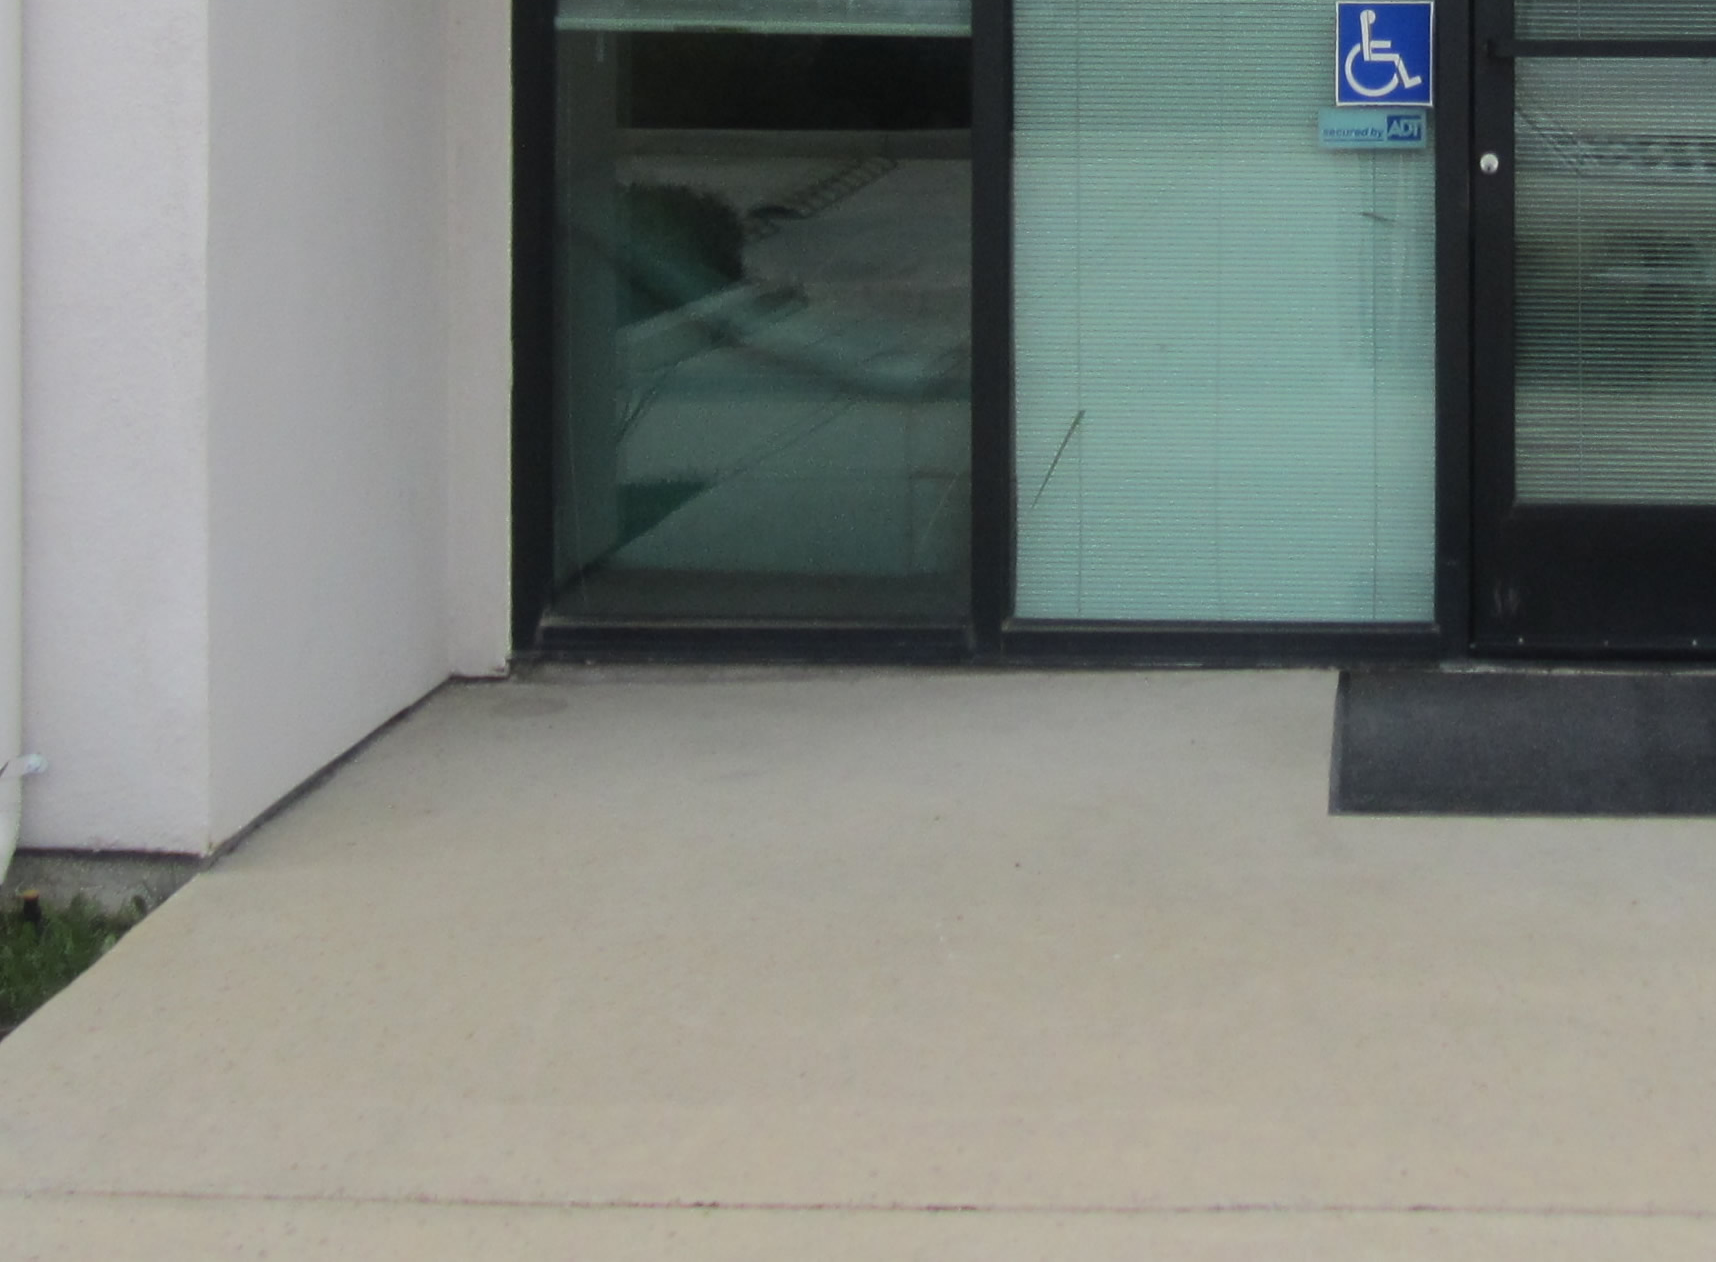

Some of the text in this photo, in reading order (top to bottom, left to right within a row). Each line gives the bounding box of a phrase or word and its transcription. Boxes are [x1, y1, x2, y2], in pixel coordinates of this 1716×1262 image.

[1323, 118, 1421, 139] secured by ADT
